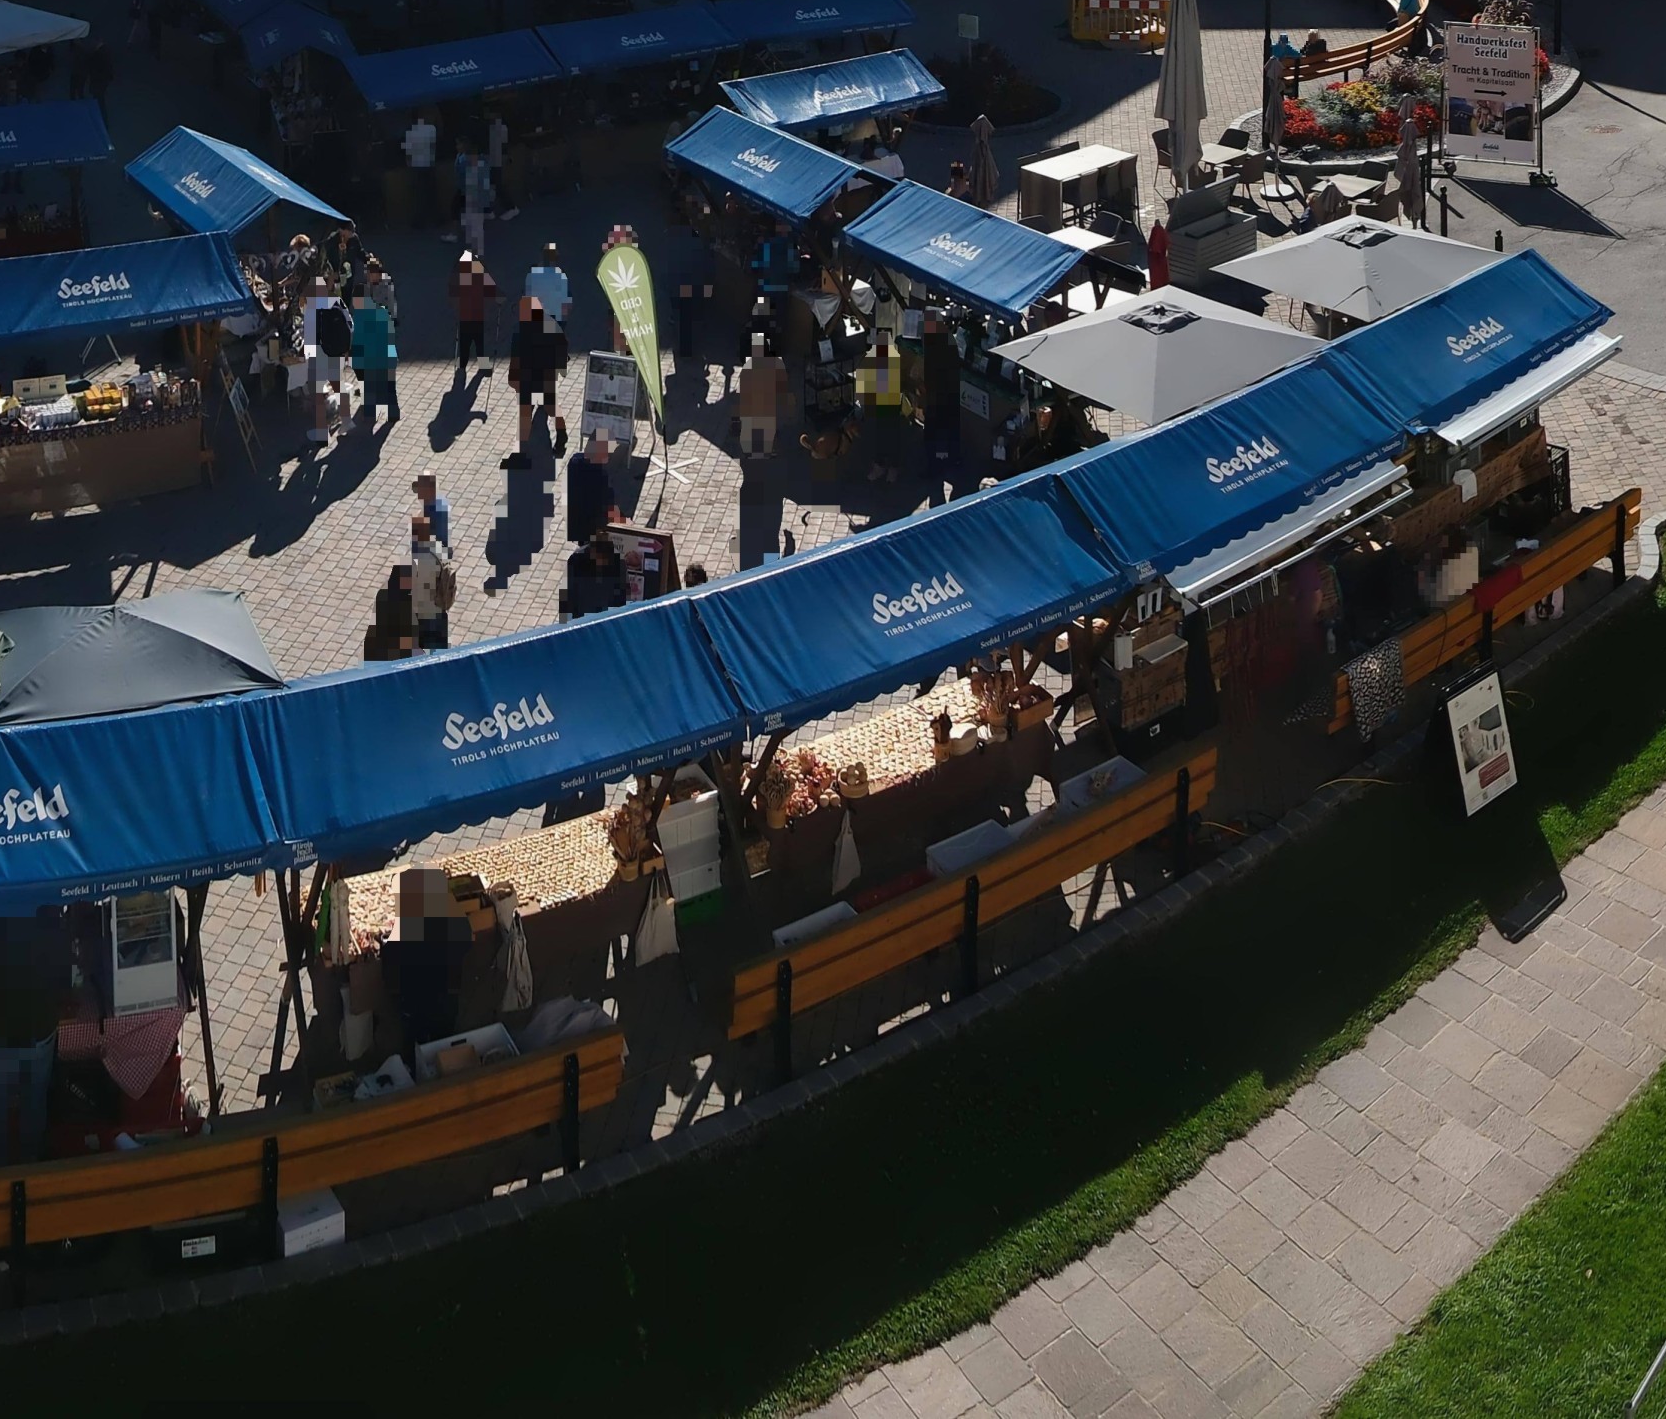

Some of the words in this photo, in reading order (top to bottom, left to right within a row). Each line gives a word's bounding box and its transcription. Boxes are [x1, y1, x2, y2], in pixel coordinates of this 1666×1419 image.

[794, 7, 840, 22] Seefeld
[620, 31, 664, 47] Seefeld
[1457, 34, 1527, 49] Handwerksfest
[1475, 47, 1508, 59] Seefeld
[430, 57, 479, 77] Seefeld
[1453, 65, 1480, 75] Tracht
[1491, 69, 1530, 79] Tradition
[1477, 77, 1515, 86] Kapitelsaal
[737, 147, 781, 173] Seefeld
[181, 171, 217, 200] Seefeld
[930, 232, 983, 261] Seefeld
[56, 270, 131, 300] Seefeld
[62, 297, 85, 309] TIROLS
[86, 291, 133, 306] HOCHPLATEAU
[1447, 316, 1504, 356] Seefeld
[1205, 434, 1281, 485] Seefeld
[1219, 478, 1244, 495] TIROLS
[1244, 458, 1289, 484] HOCHPLATEAU
[872, 571, 965, 625] Seefeld
[884, 622, 914, 638] TIROLS
[914, 600, 973, 627] HOCHPLATEAU
[979, 634, 1001, 649] Seefeld
[1007, 621, 1033, 638] Leutasch
[1040, 610, 1062, 625] Mösern
[1069, 601, 1084, 613] Reith
[1089, 585, 1117, 604] Scharnitz
[441, 692, 556, 751] Seefeld
[451, 750, 487, 767] TIROLS
[489, 730, 560, 758] HOCHPLATEAU
[560, 775, 586, 790] Seefeld
[595, 763, 627, 780] Leutasch
[636, 752, 664, 768] Mösern
[673, 743, 692, 757] Reith
[700, 730, 733, 748] Scharnitz
[61, 883, 90, 898] Seefeld
[101, 878, 139, 893] Leutasch
[150, 870, 181, 885] Mösern
[191, 865, 214, 877] Reith
[223, 855, 263, 873] Scharnitz
